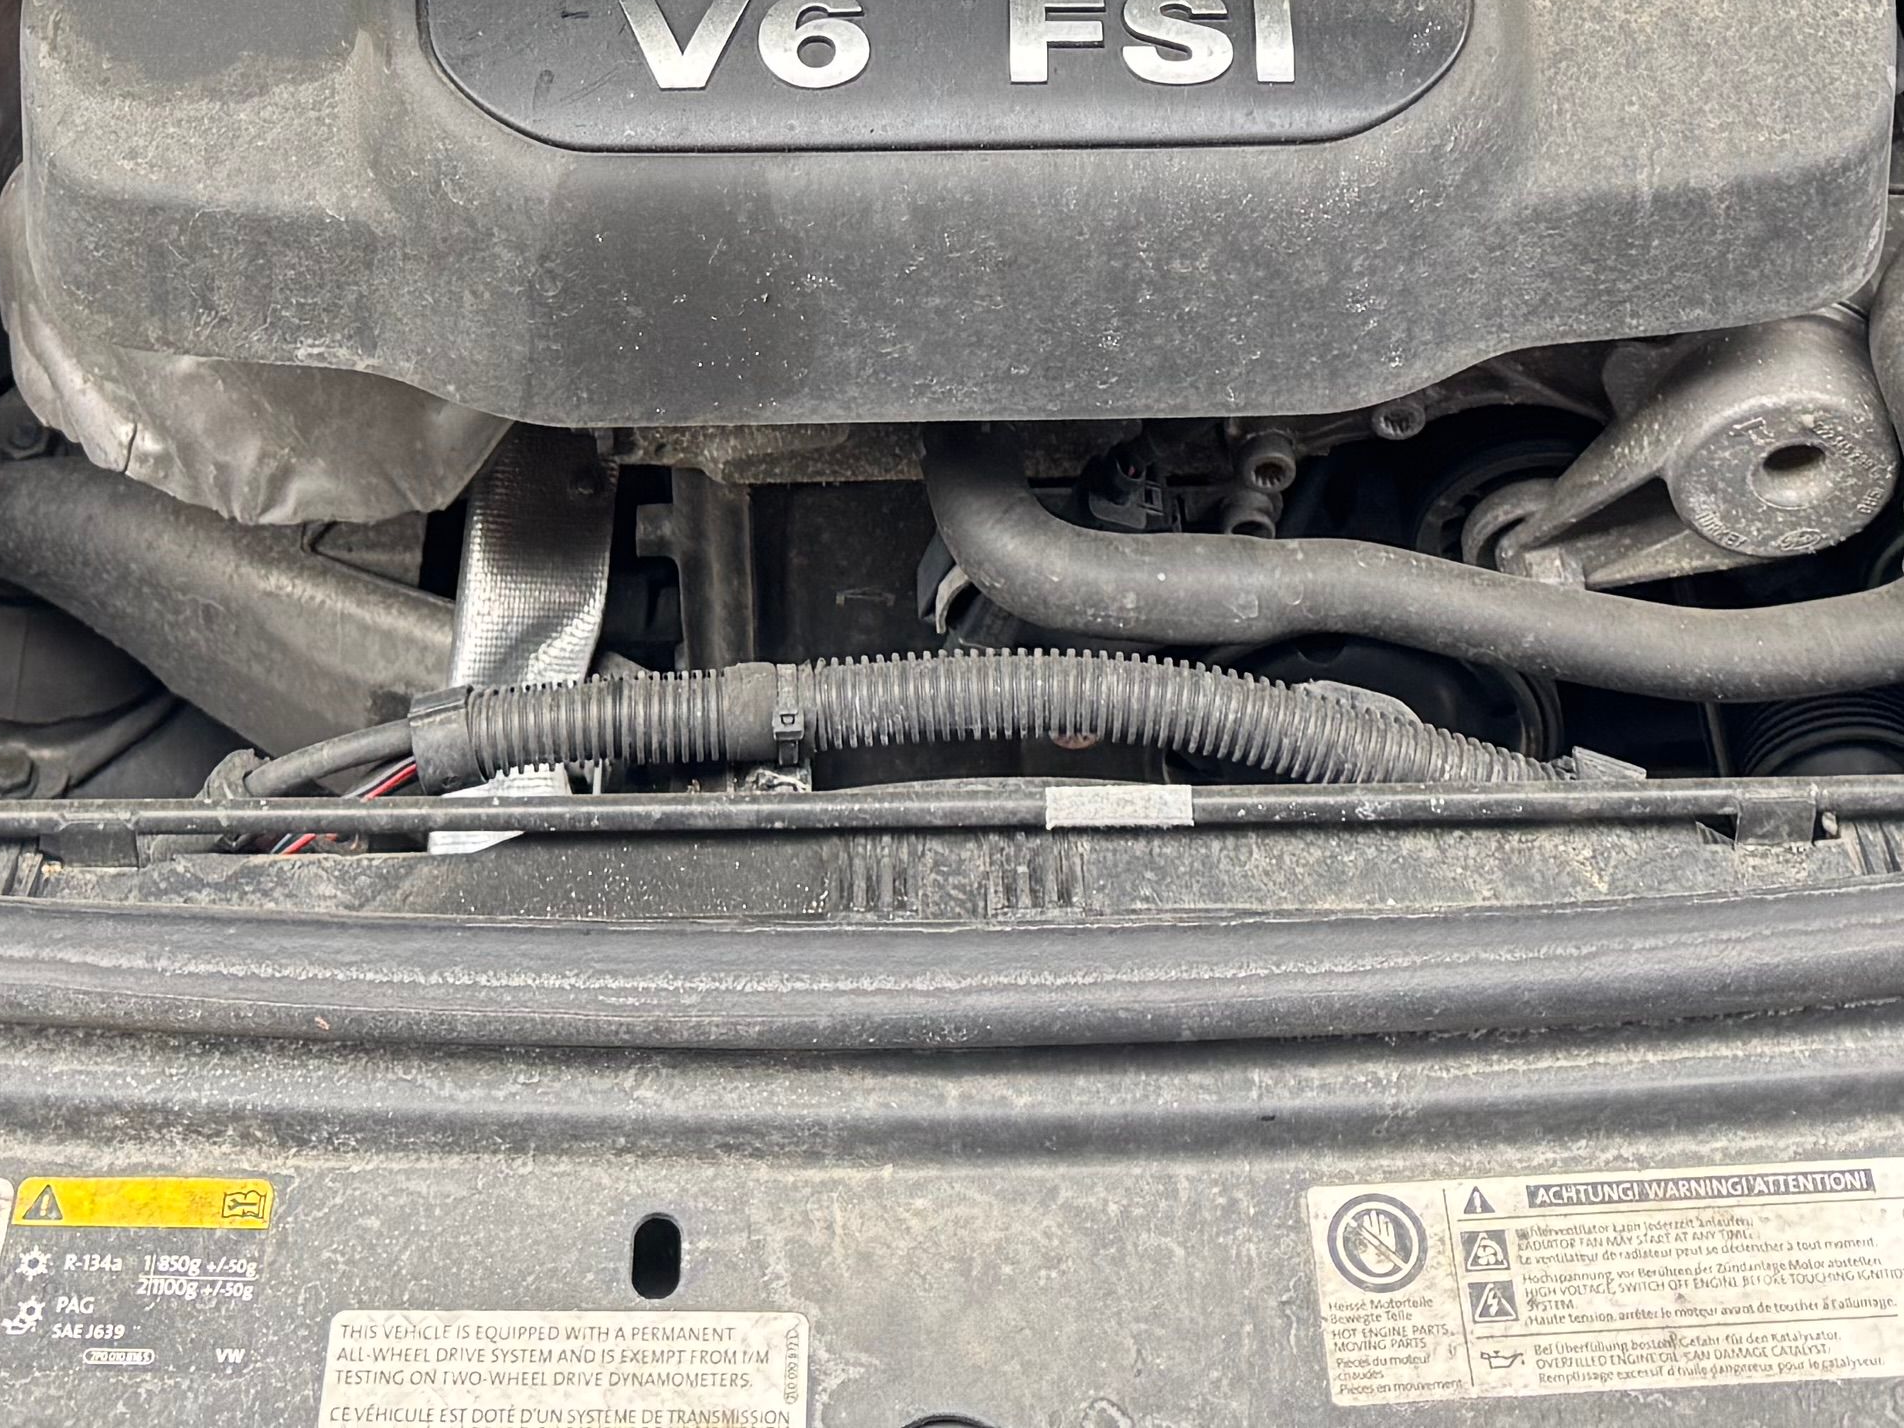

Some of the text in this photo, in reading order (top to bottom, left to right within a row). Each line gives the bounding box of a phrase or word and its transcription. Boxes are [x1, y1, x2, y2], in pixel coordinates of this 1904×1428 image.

[64, 1253, 123, 1272] R-134a
[157, 1255, 202, 1276] 850g
[206, 1257, 258, 1277] +/-50g
[202, 1281, 254, 1301] +/-50g
[56, 1296, 95, 1314] PAG
[52, 1323, 125, 1339] SAE J639
[340, 1324, 737, 1344] THIS VEHICLE IS EQUIPPED WITH A PERMANENT
[1332, 1326, 1408, 1340] HOT ENGINE
[1334, 1337, 1427, 1353] MOVING PARTS
[215, 1348, 245, 1364] VW
[336, 1347, 431, 1363] ALL-WHEEL
[436, 1347, 485, 1363] DRIVE
[491, 1348, 552, 1364] SYSTEM
[558, 1347, 596, 1364] AND
[601, 1349, 615, 1364] IS
[620, 1349, 687, 1365] EXEMPT
[690, 1350, 737, 1365] FROM
[336, 1369, 753, 1388] TESTING ON TWO-WHEEL DRIVE DYNAMOMETERS.
[330, 1407, 350, 1421] CE
[355, 1404, 434, 1423] VÉHICULE
[440, 1408, 468, 1423] EST
[472, 1404, 514, 1424] DOTÉ
[642, 1410, 663, 1424] DE
[668, 1409, 790, 1425] TRANSMISSION
